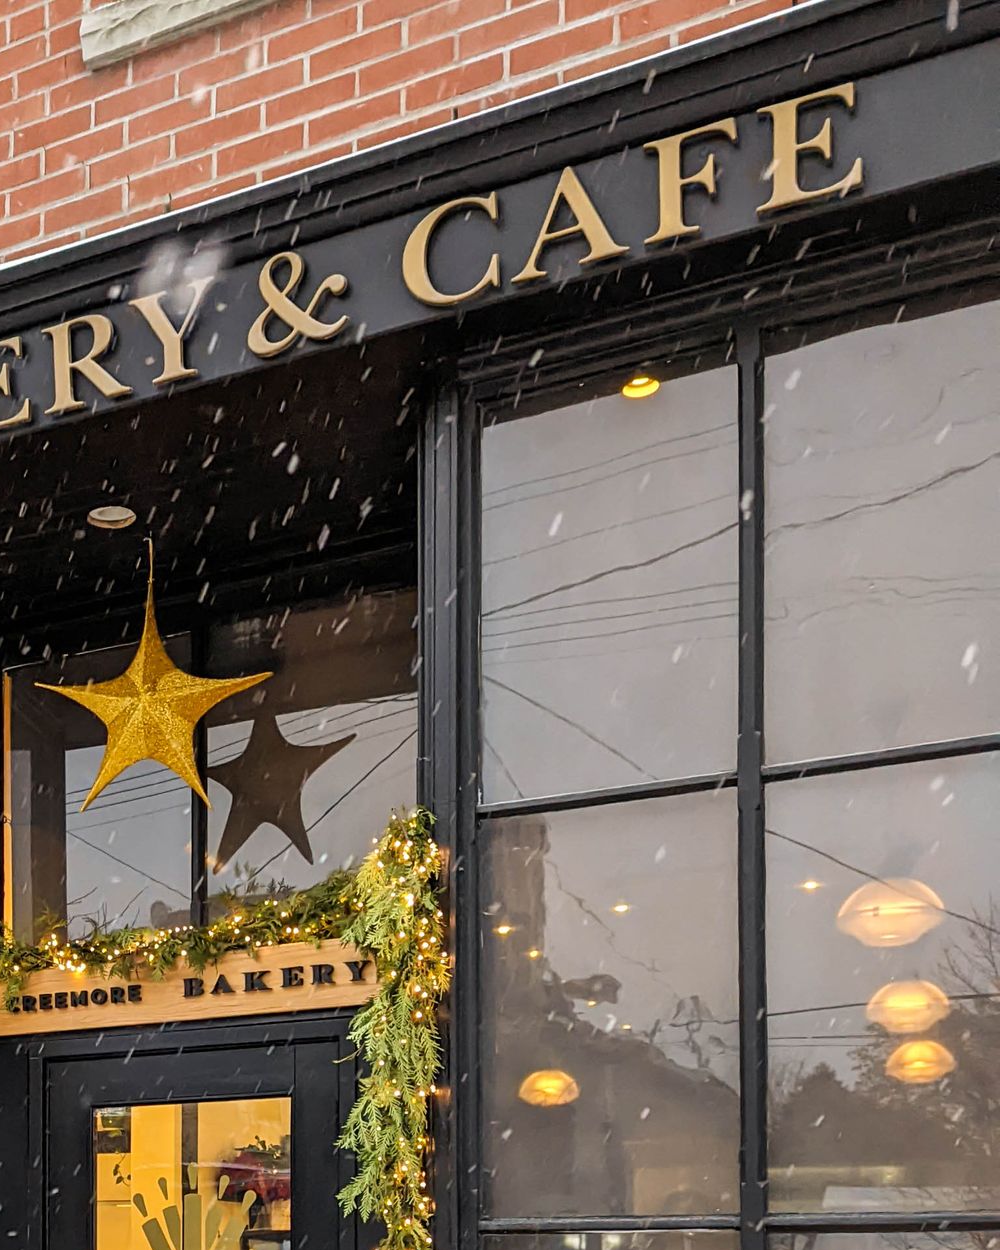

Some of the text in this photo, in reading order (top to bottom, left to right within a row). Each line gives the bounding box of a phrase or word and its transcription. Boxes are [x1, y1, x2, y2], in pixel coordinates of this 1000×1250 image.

[246, 250, 349, 358] &
[401, 80, 864, 307] CAFE
[8, 960, 373, 1013] CREEMORE BAKERY
